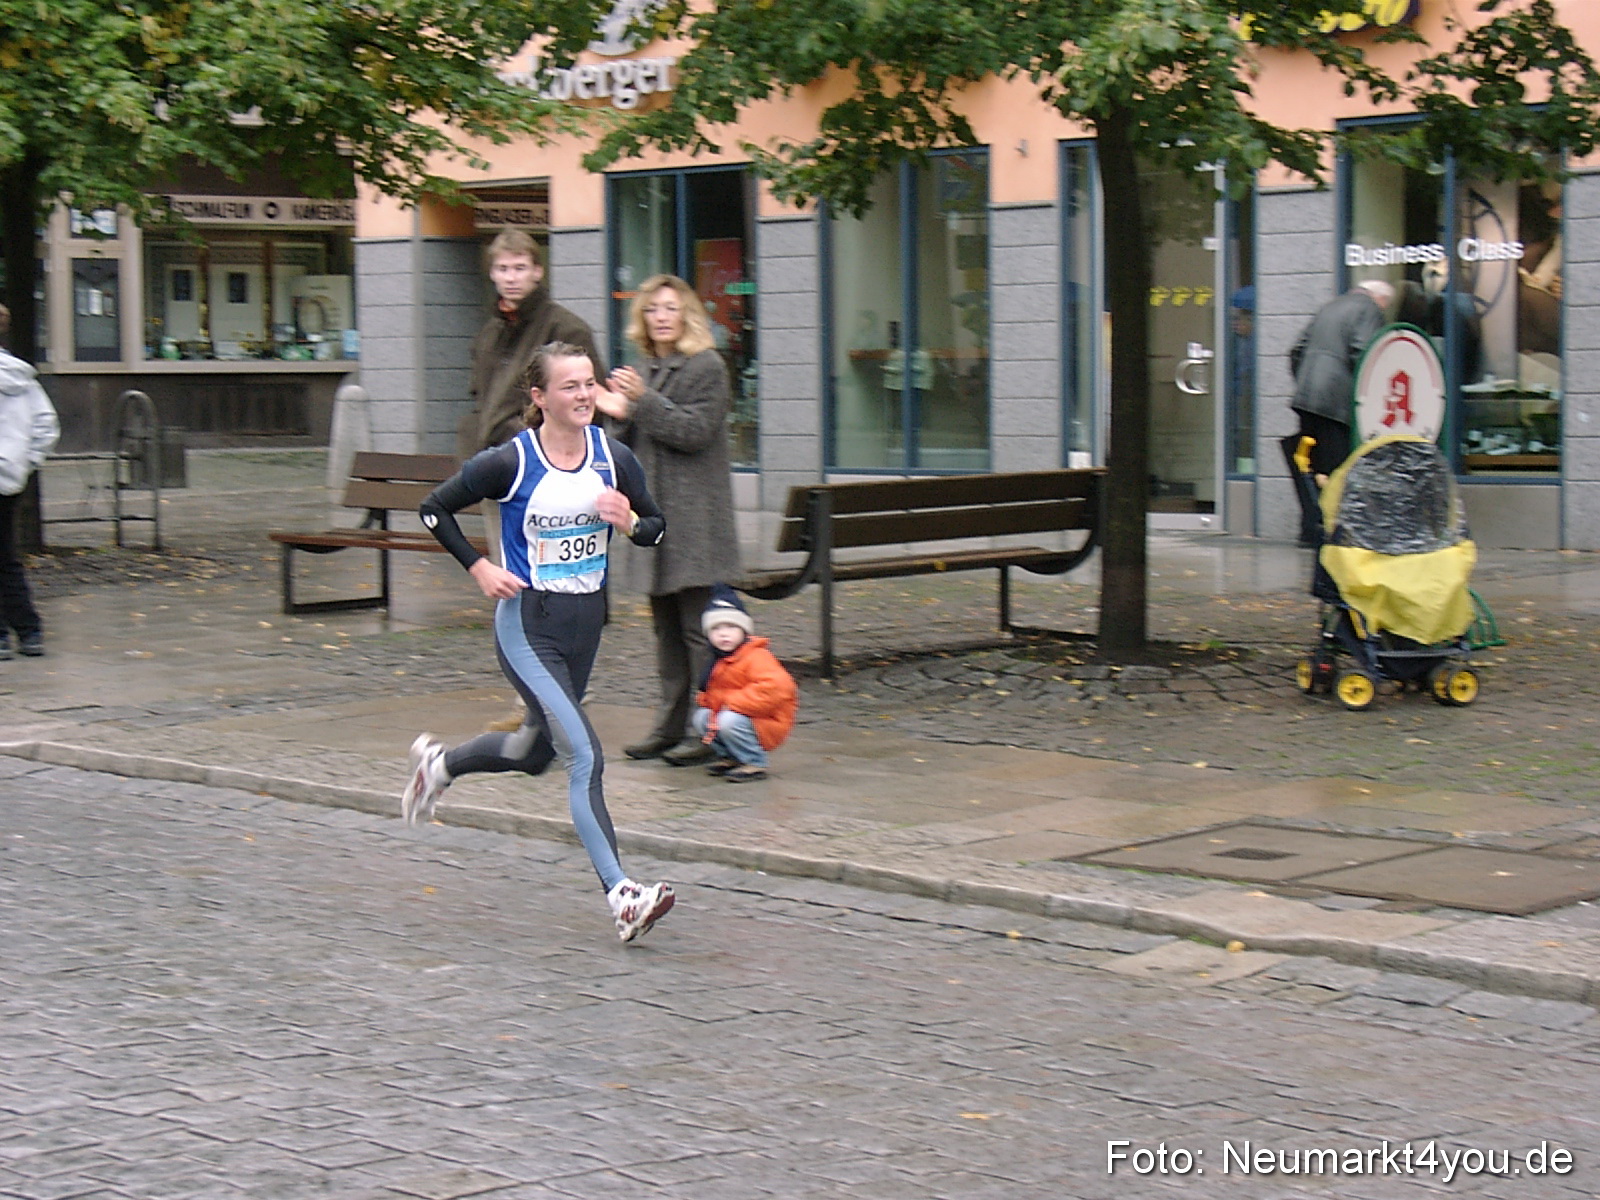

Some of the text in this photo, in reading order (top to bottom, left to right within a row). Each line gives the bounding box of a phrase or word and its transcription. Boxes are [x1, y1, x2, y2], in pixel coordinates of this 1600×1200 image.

[1344, 237, 1524, 266] Business Class
[558, 534, 597, 562] 396
